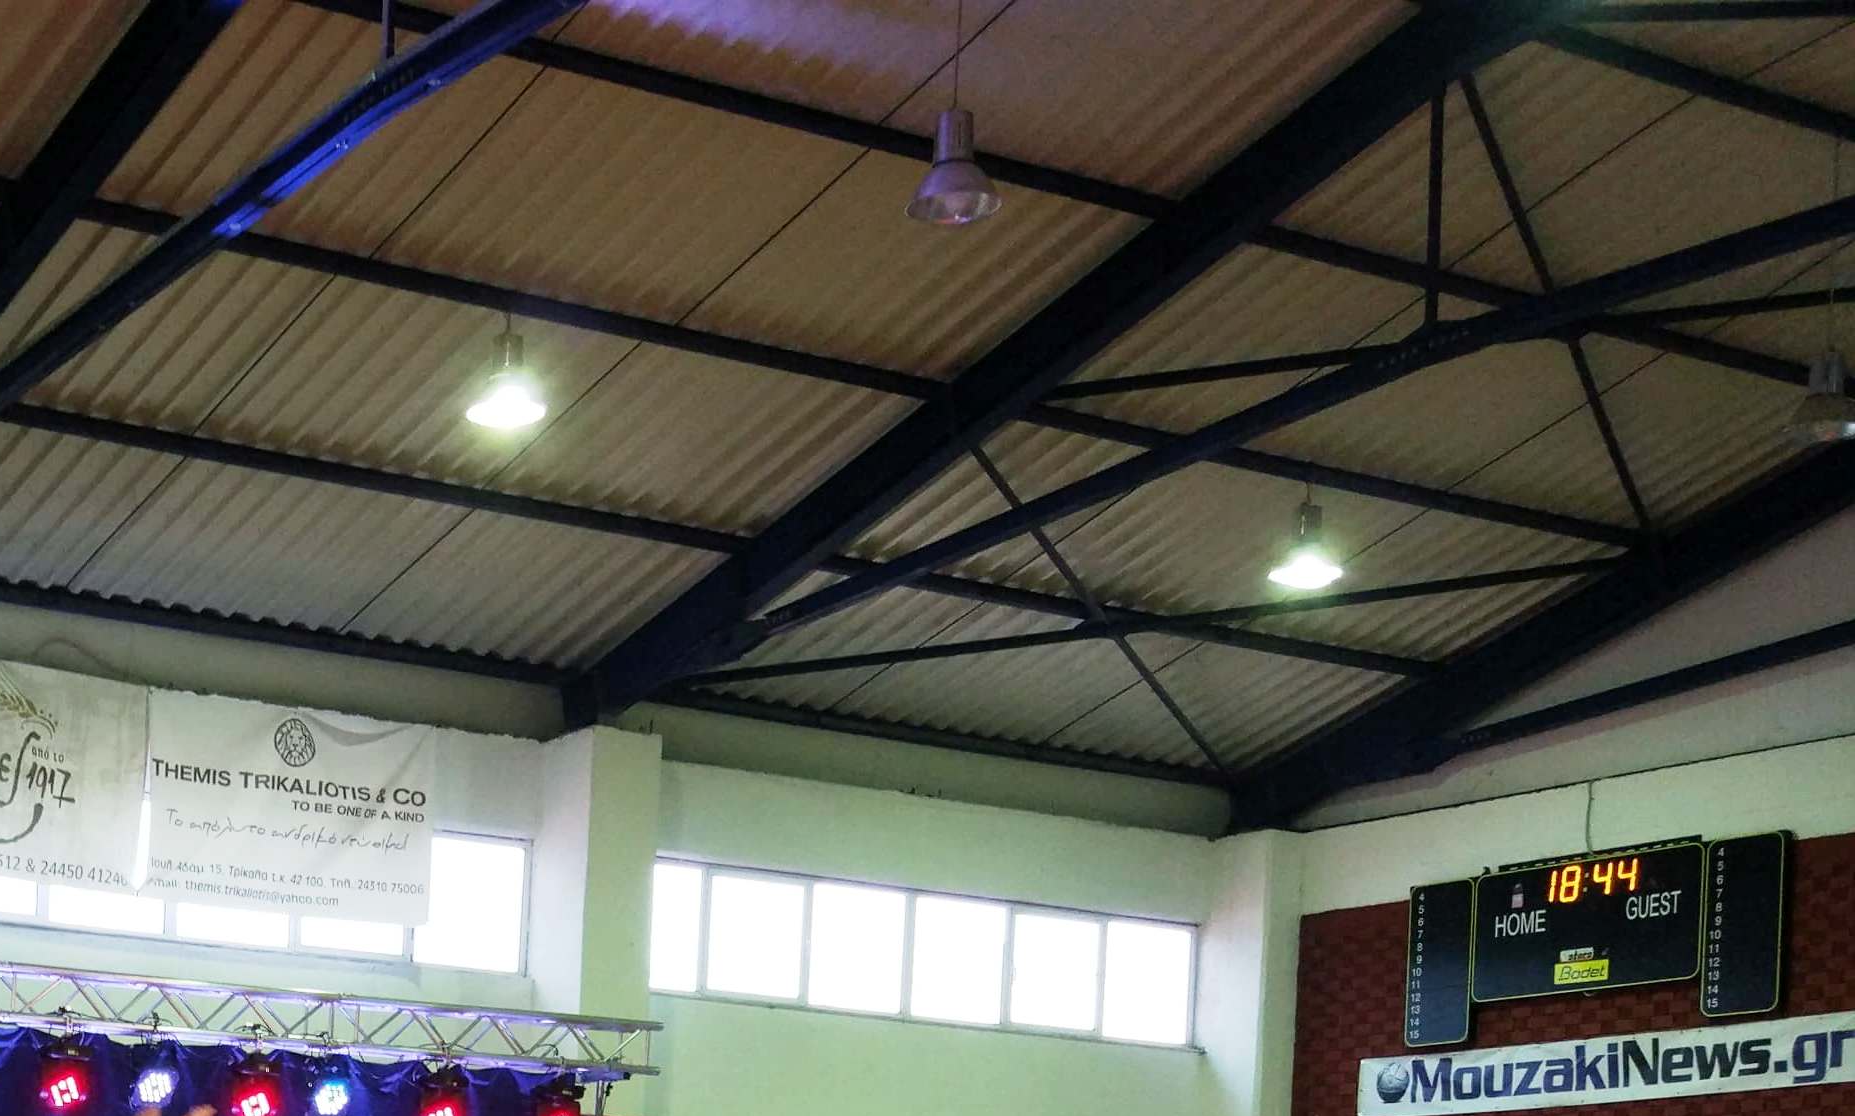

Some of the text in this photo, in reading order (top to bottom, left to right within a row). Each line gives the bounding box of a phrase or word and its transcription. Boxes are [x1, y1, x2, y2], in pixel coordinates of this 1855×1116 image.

[26, 761, 75, 808] 1917
[152, 758, 426, 807] THEMIS TRIKALIOTIS & CO
[291, 800, 425, 823] TO BE ONE OF A KIND
[25, 858, 36, 873] &
[40, 857, 83, 880] 24450
[1548, 858, 1639, 903] 18:44
[1625, 890, 1682, 920] GUEST
[1495, 909, 1546, 938] HOME
[1709, 929, 1721, 940] 10
[1708, 944, 1719, 954] 11
[1708, 957, 1720, 967] 12
[1412, 967, 1422, 977] 10
[1708, 970, 1719, 981] 13
[1411, 980, 1420, 989] 11
[1707, 984, 1718, 995] 14
[1411, 993, 1421, 1002] 12
[1707, 998, 1718, 1009] 15
[1410, 1005, 1420, 1015] 13
[1410, 1017, 1420, 1027] 14
[1409, 1030, 1419, 1039] 15
[1410, 1029, 1855, 1103] MouzakiNews.gr
